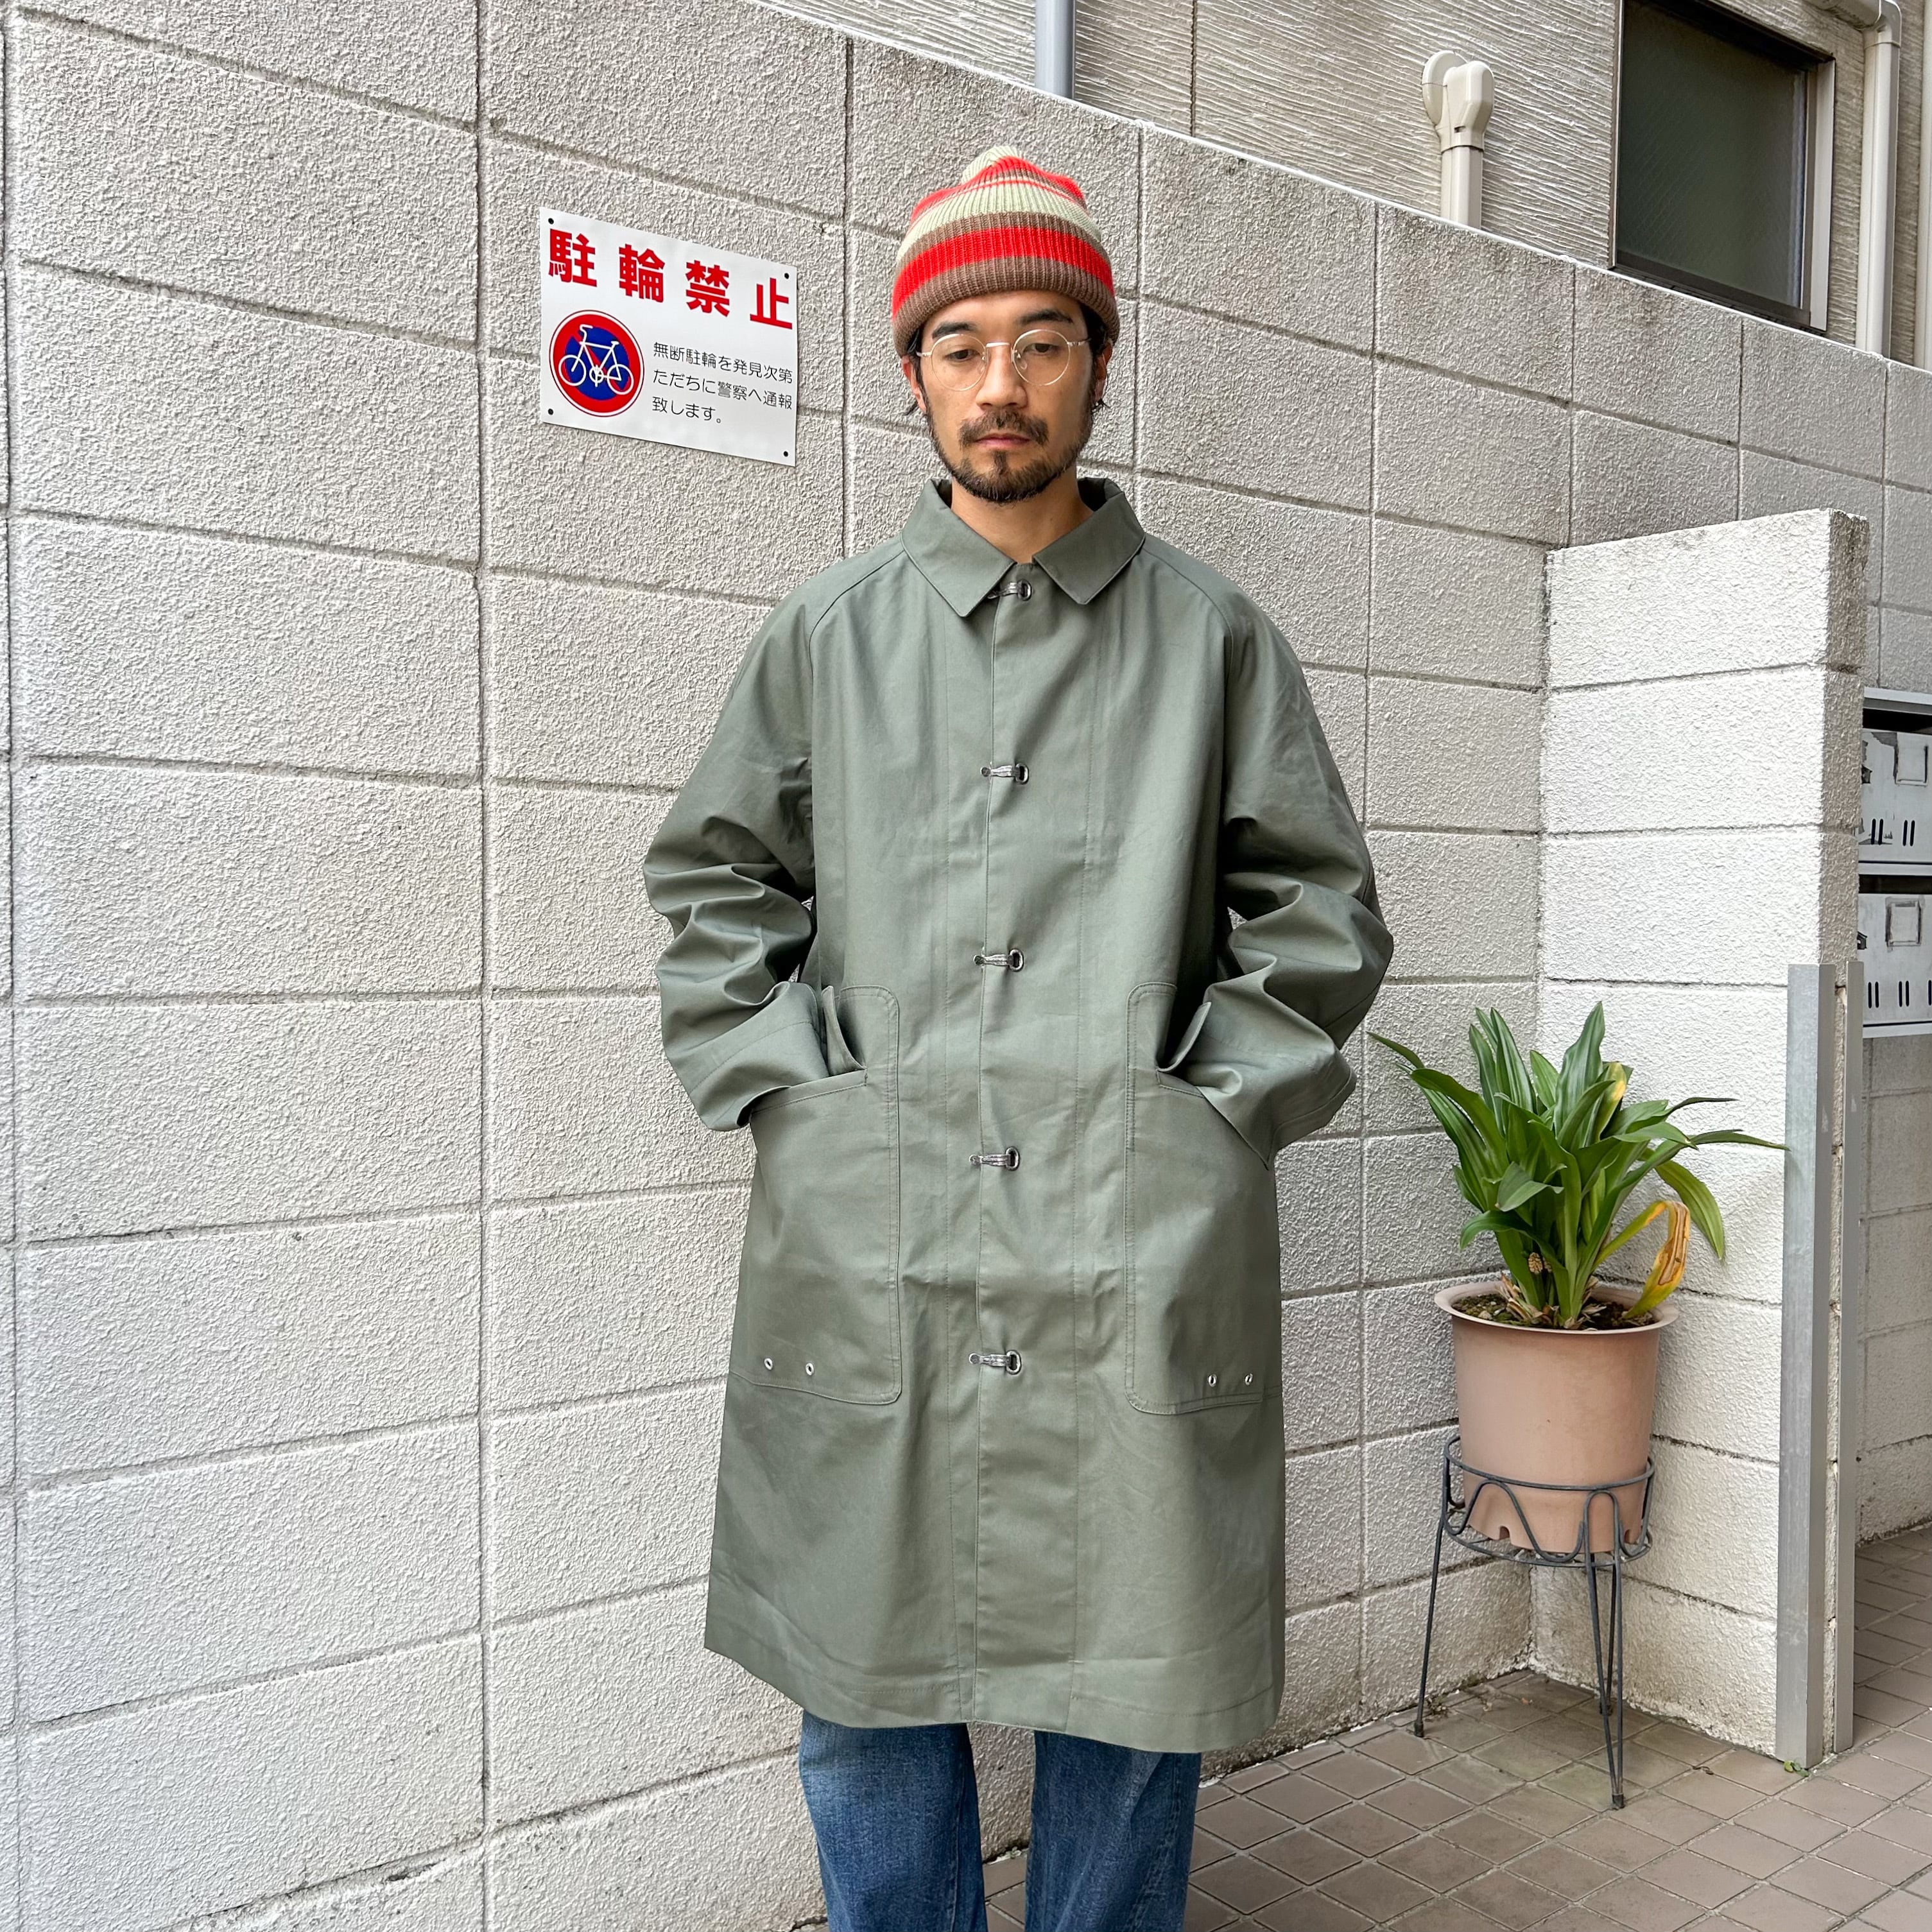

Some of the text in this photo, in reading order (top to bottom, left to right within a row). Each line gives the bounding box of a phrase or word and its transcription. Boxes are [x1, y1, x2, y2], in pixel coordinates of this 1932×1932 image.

[549, 229, 792, 329] 駐輪禁止
[653, 341, 793, 384] 無断駐輪を発見次第
[652, 396, 721, 424] 致します。
[653, 369, 792, 410] ただちに警察へ通報
